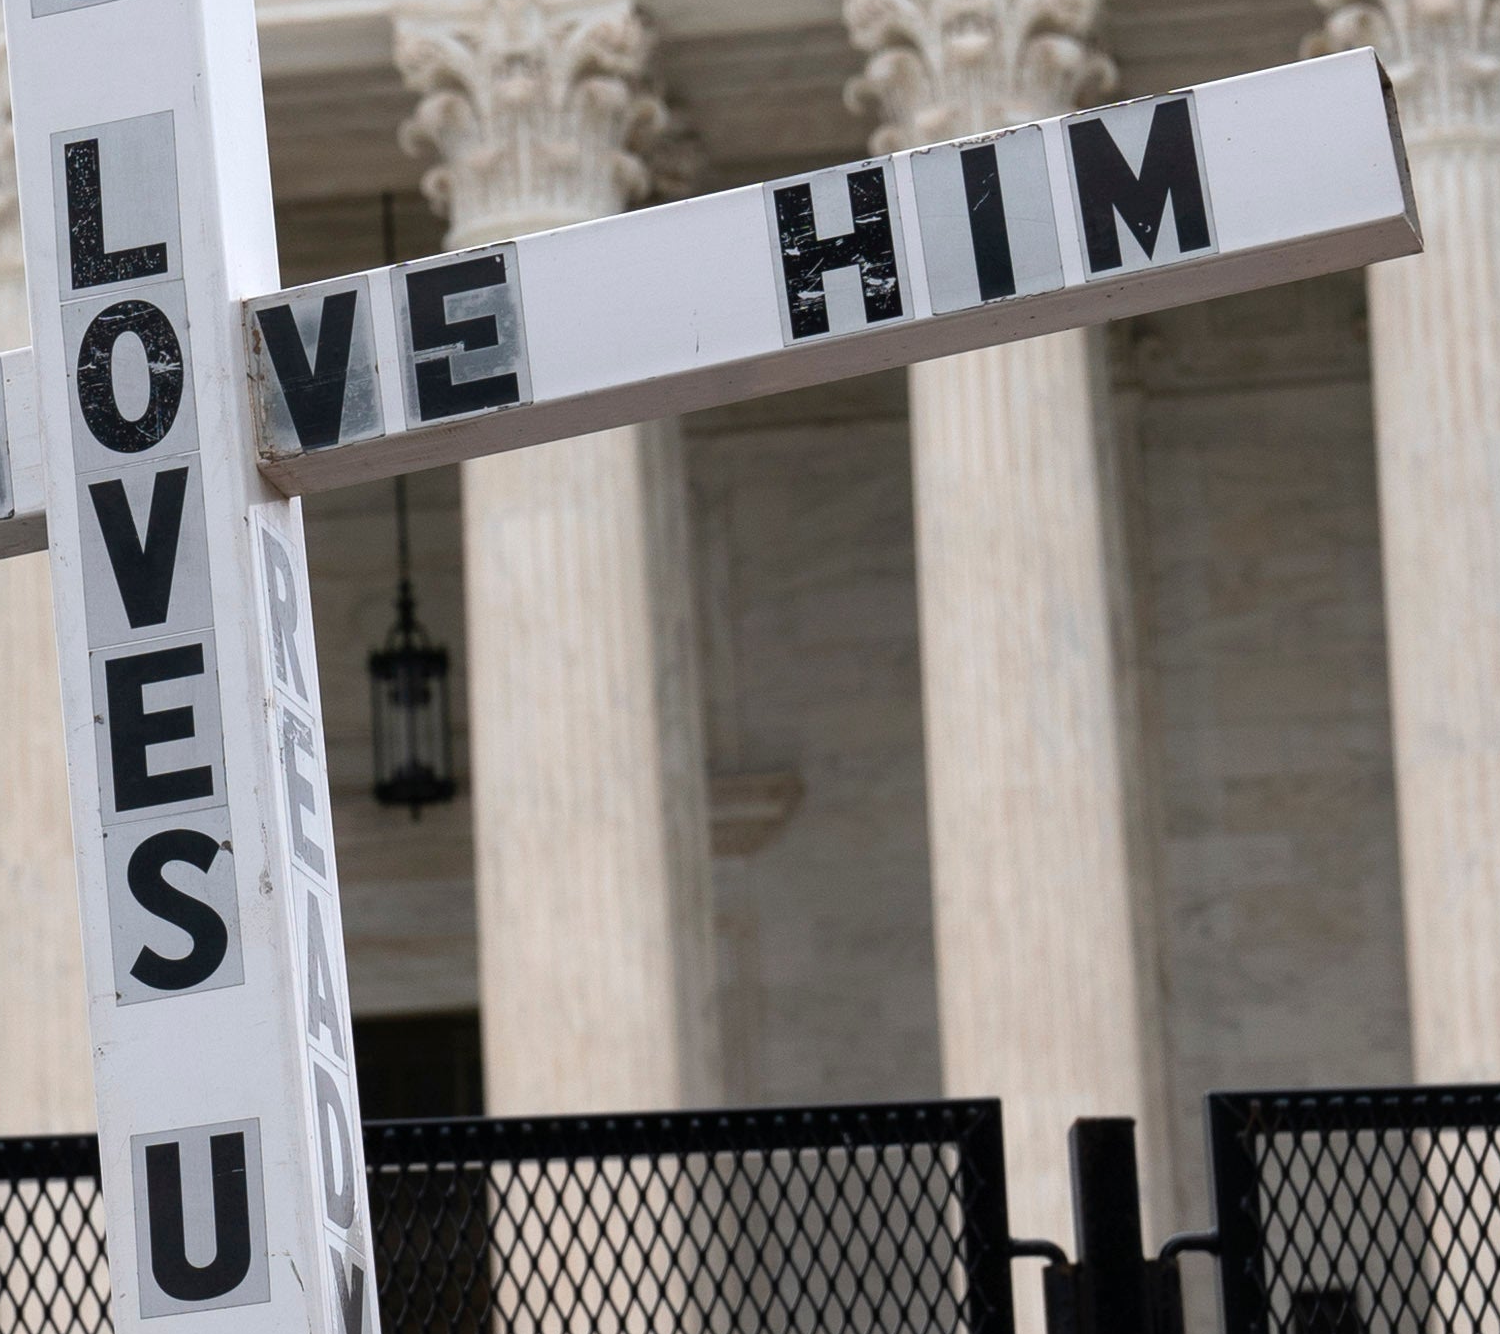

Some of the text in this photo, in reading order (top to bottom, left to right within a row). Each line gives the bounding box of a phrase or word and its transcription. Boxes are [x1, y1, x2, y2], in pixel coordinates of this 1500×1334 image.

[772, 99, 1207, 340] HIM
[63, 138, 228, 990] LOVES
[144, 1124, 254, 1304] U
